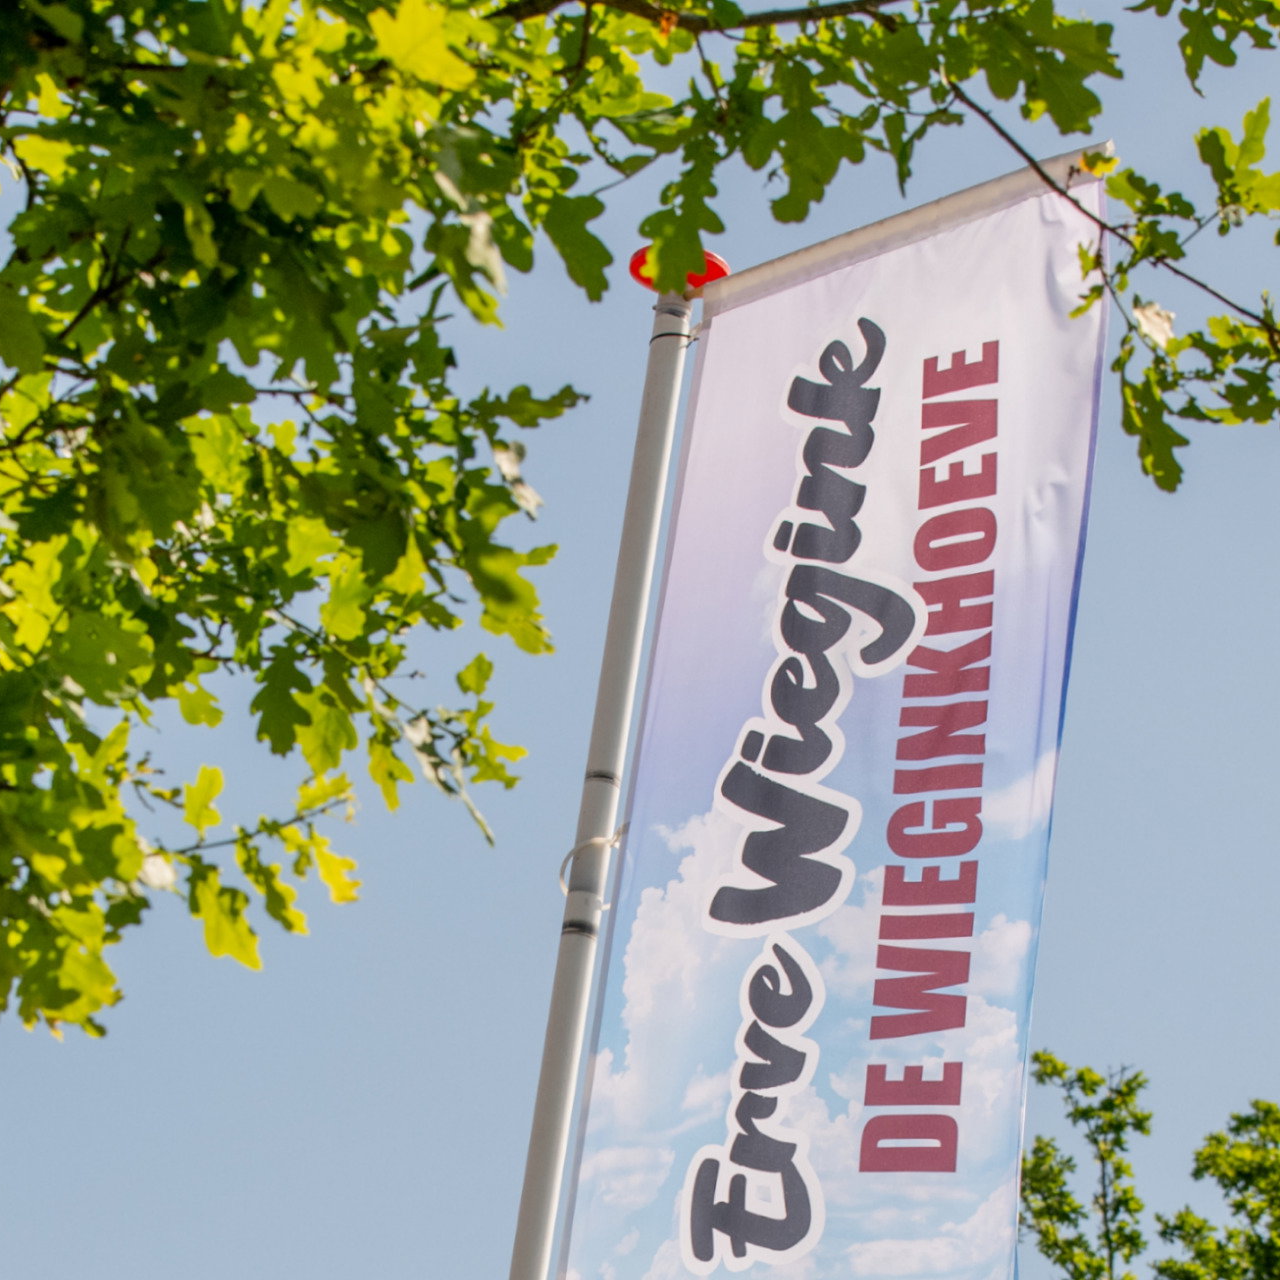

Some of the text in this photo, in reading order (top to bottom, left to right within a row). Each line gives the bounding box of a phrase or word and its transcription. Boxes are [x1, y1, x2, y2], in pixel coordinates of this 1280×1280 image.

[690, 317, 916, 1262] Erve Wiegink
[859, 340, 1000, 1172] DE WIEGINKHOEVE
